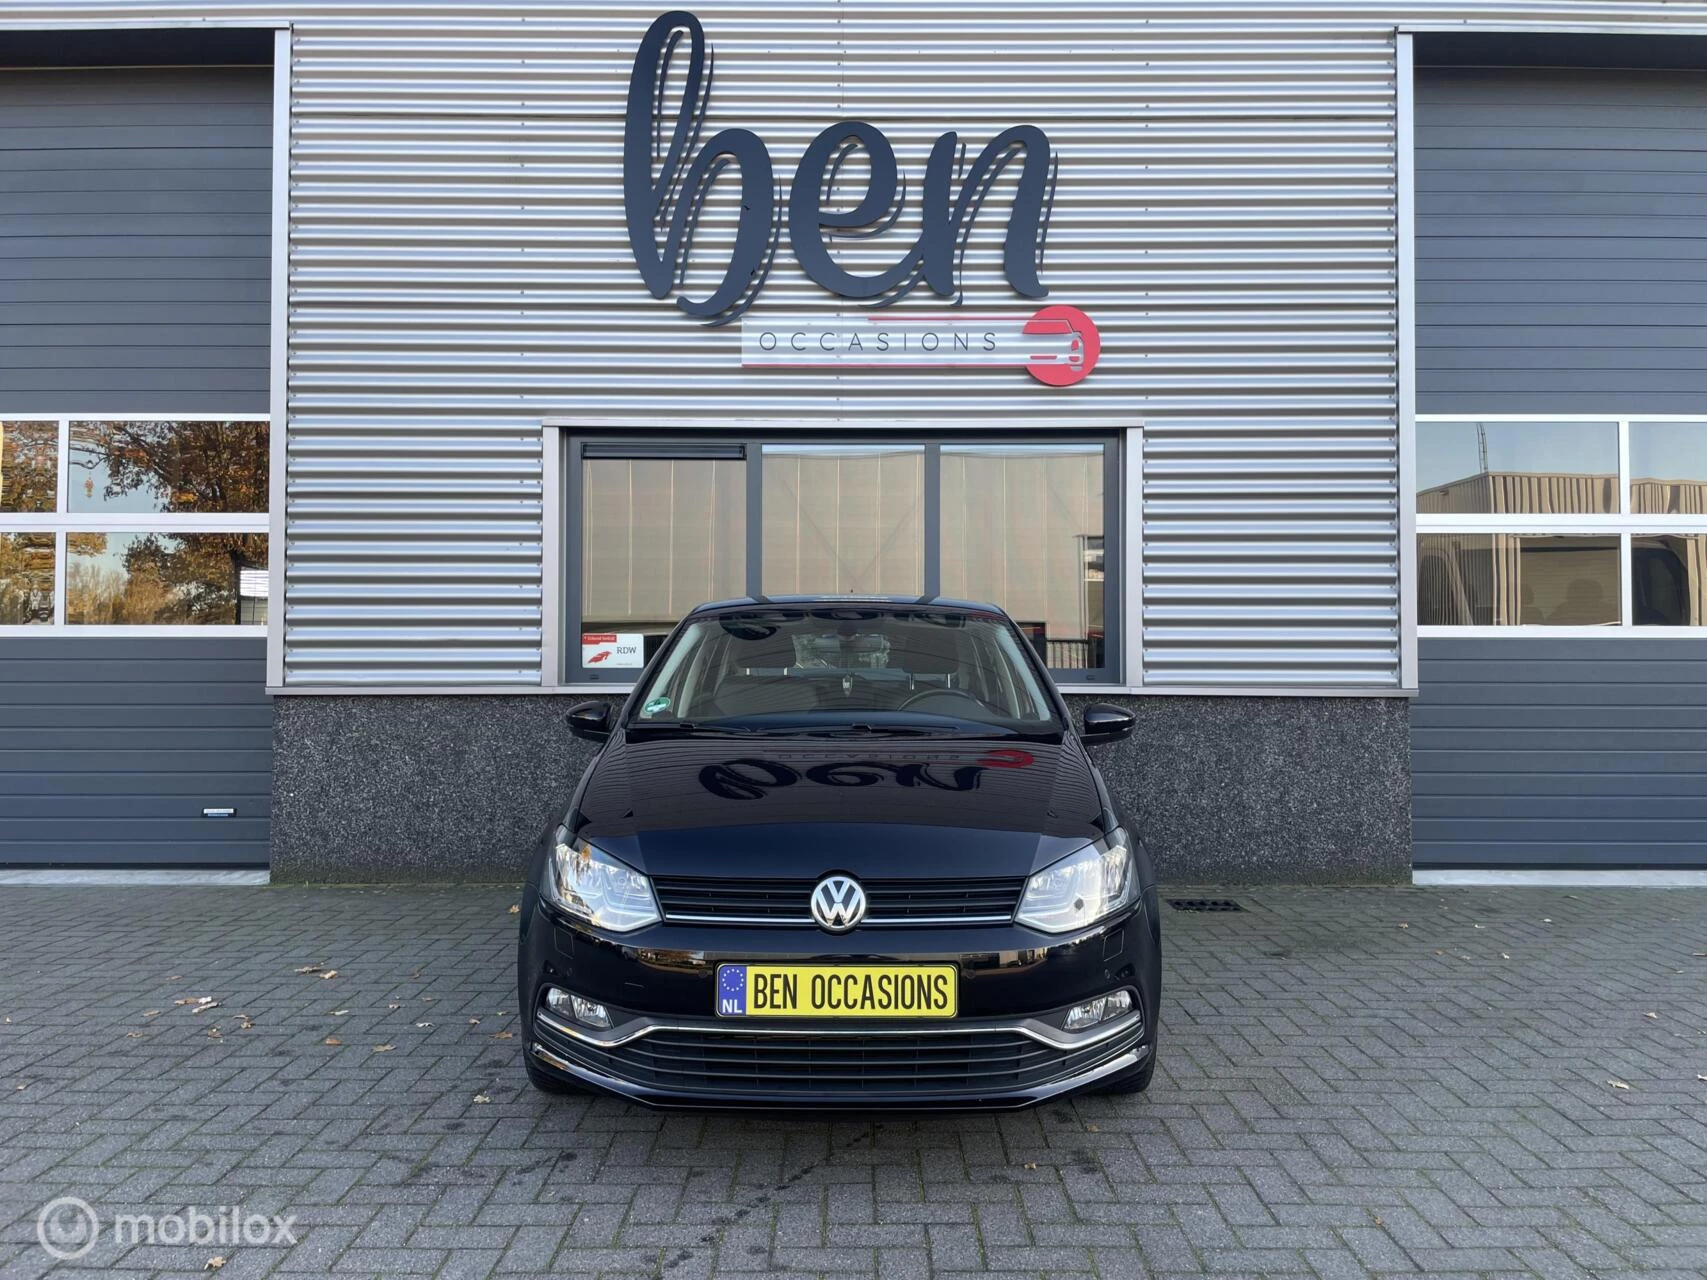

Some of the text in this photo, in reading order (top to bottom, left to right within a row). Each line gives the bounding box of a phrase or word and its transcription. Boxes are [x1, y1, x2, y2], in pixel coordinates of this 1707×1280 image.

[623, 10, 1056, 322] ben
[759, 331, 997, 352] OCCASIONS
[616, 646, 637, 655] RDW
[753, 973, 948, 1010] BEN OCCASIONS
[722, 1000, 743, 1014] NL
